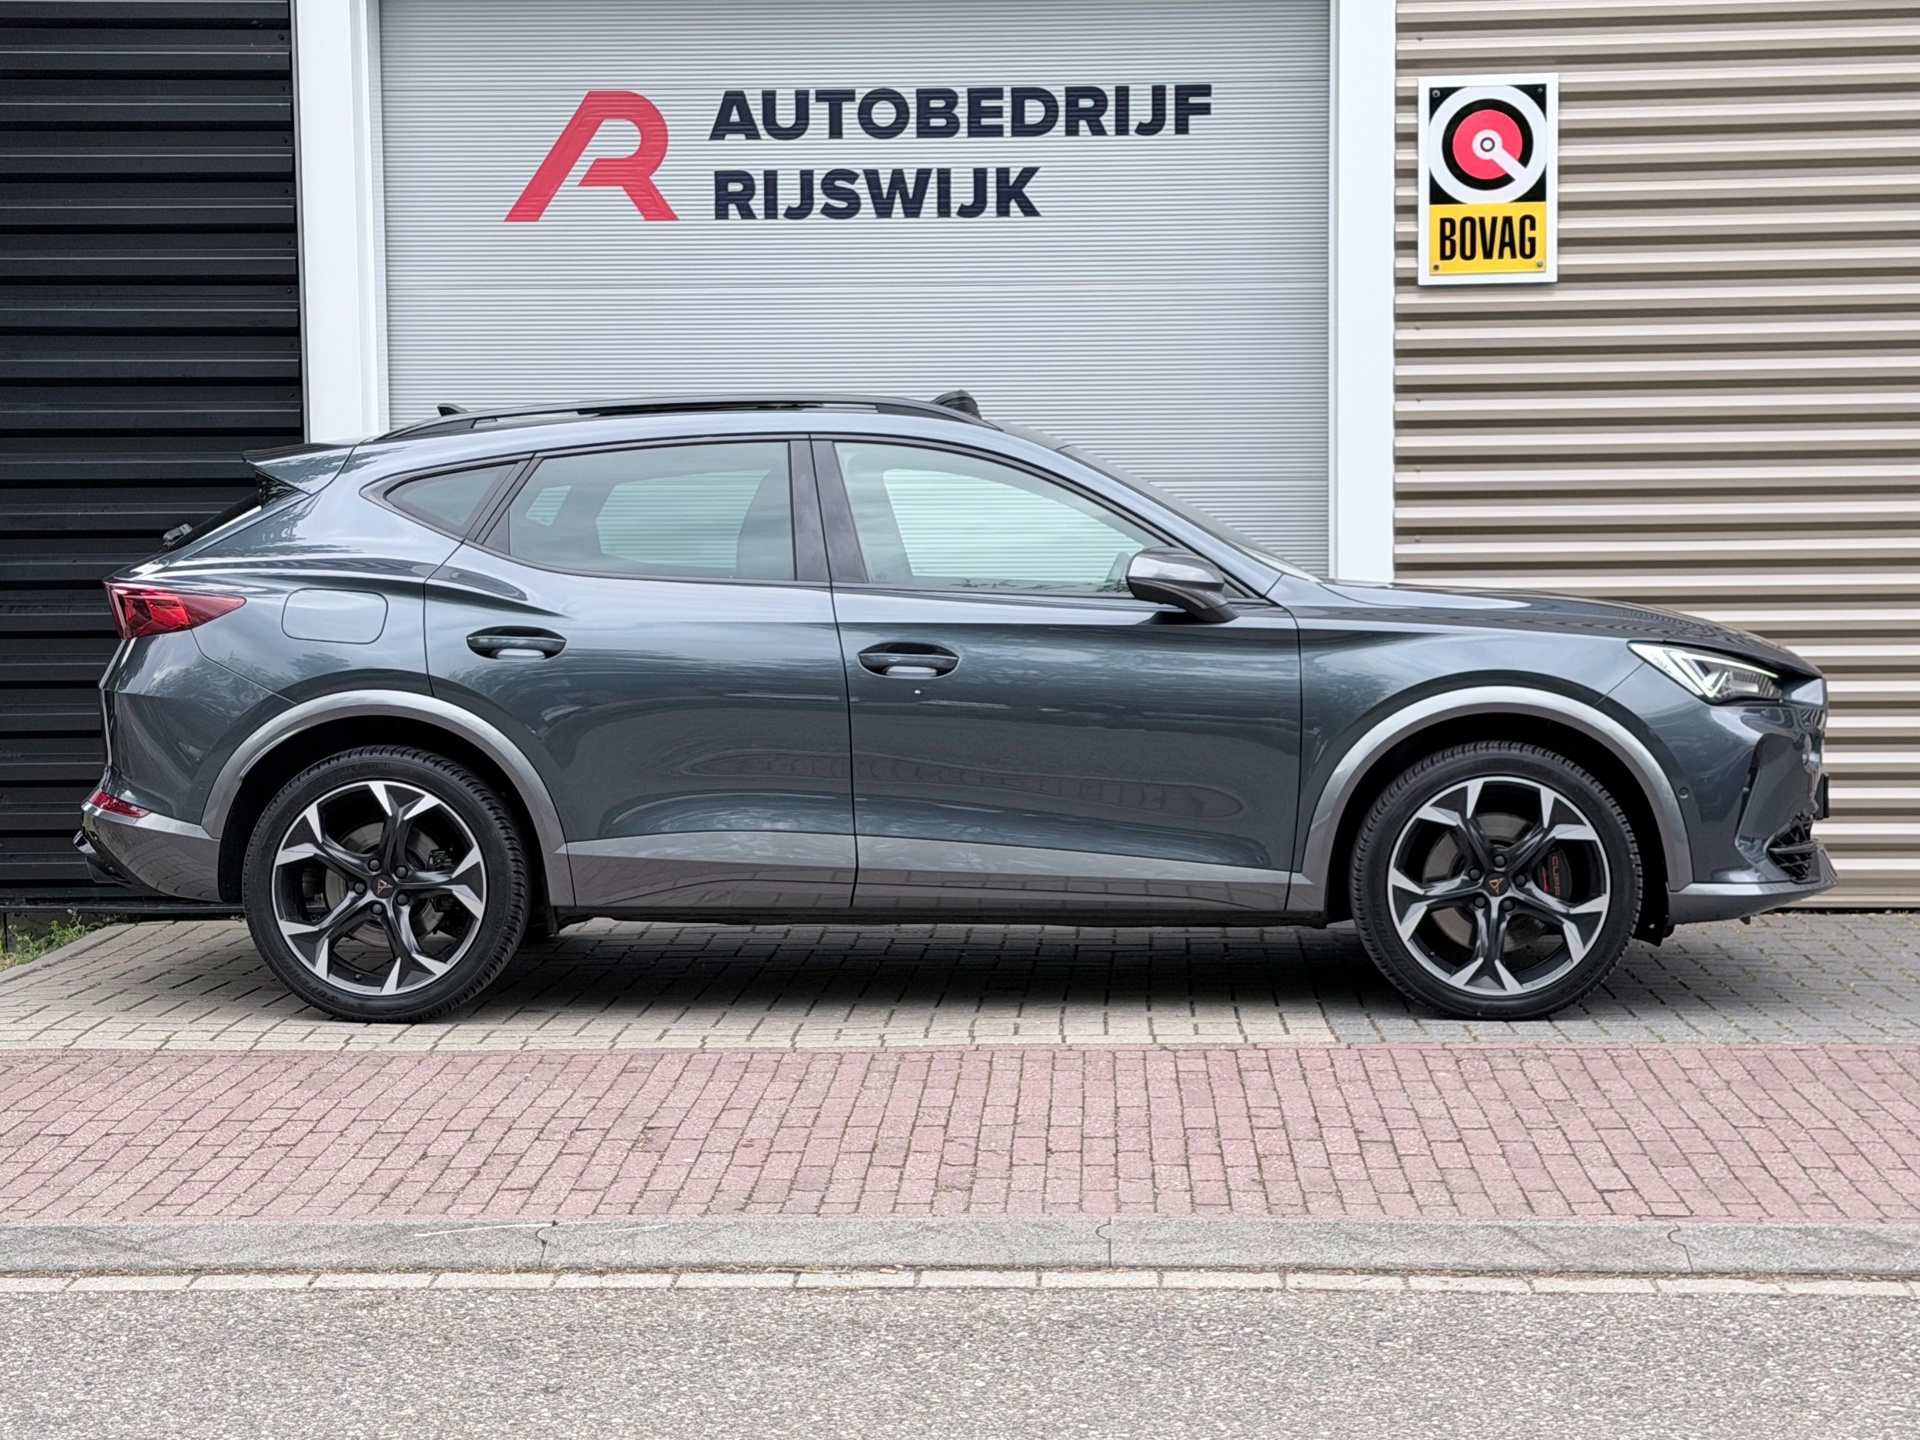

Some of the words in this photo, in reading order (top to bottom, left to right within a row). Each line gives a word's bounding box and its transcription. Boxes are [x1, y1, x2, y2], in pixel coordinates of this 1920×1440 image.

[709, 85, 1211, 140] AUTOBEDRIJF
[714, 167, 1041, 220] RIJSWIJK
[1439, 215, 1536, 260] BOVAG
